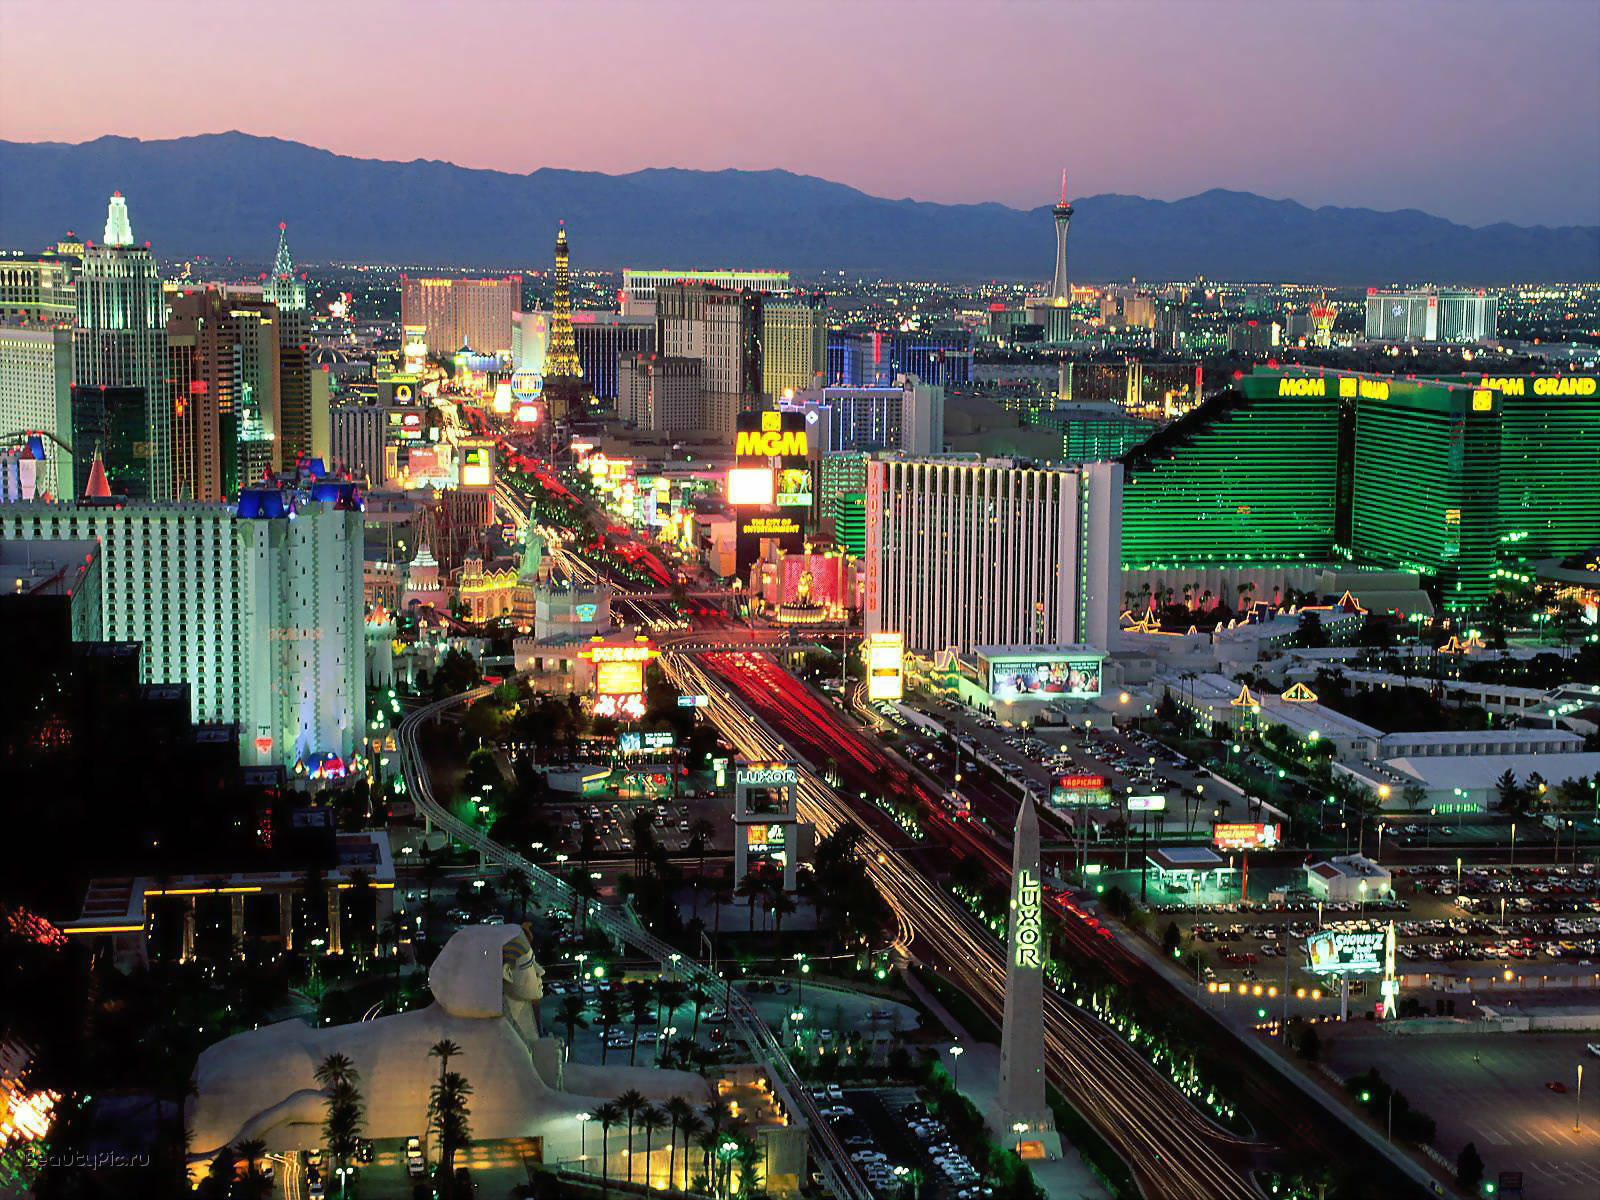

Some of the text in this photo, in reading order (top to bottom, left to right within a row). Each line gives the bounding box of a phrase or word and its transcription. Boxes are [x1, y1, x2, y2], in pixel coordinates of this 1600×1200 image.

[1279, 378, 1326, 397] MGM
[1533, 377, 1597, 396] GRAND
[736, 431, 809, 457] MGM
[743, 525, 800, 533] ENTERTAINMENT
[751, 518, 765, 526] THE
[736, 769, 798, 784] LUXOR
[1062, 778, 1102, 787] TROPICANA
[1017, 870, 1041, 968] LUXOR
[1335, 933, 1385, 952] SHOWBIZ
